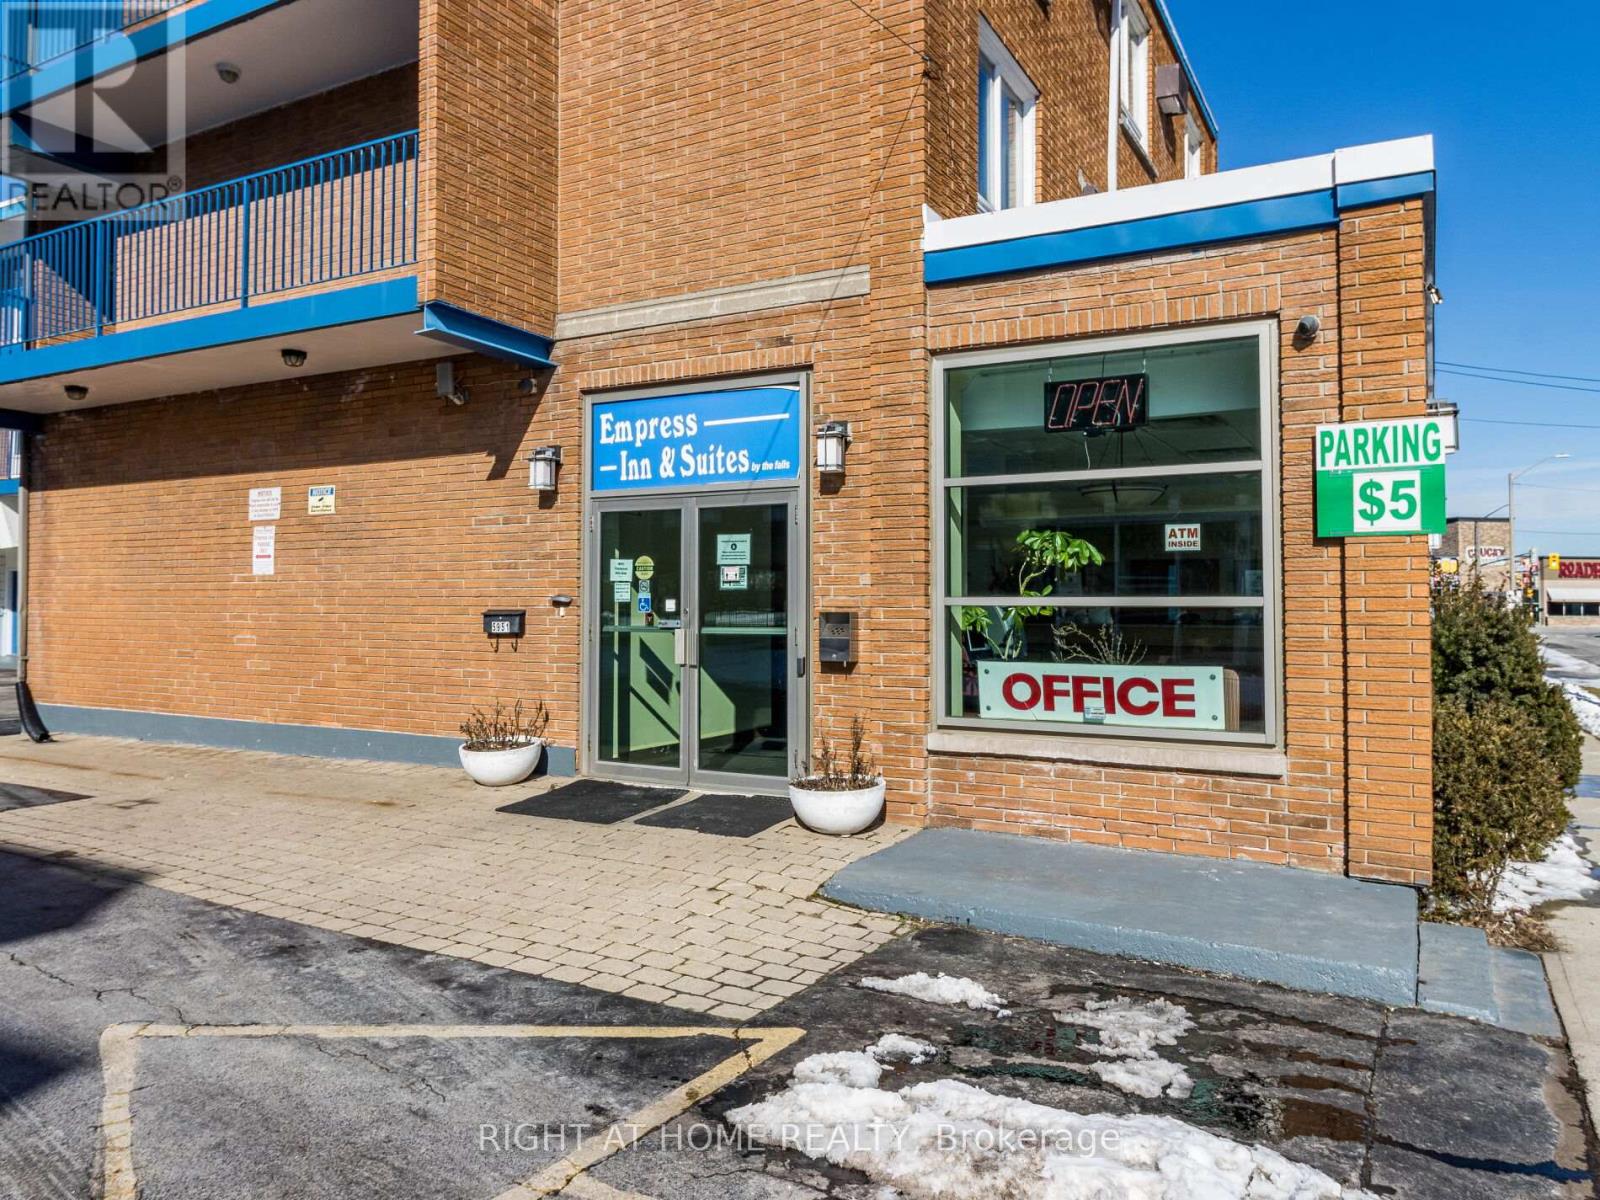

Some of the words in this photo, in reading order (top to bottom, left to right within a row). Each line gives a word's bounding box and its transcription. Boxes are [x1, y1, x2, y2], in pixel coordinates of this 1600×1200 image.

[1048, 378, 1144, 428] OPEN
[599, 412, 698, 447] Empress
[1319, 421, 1441, 468] PARKING
[619, 450, 653, 481] Inn
[659, 446, 676, 479] &
[680, 444, 750, 478] Suites
[751, 461, 761, 473] by
[761, 460, 774, 471] the
[1357, 478, 1417, 526] $5
[1168, 527, 1198, 539] ATM
[1168, 540, 1199, 548] INSIDE
[1002, 672, 1196, 719] OFFICE
